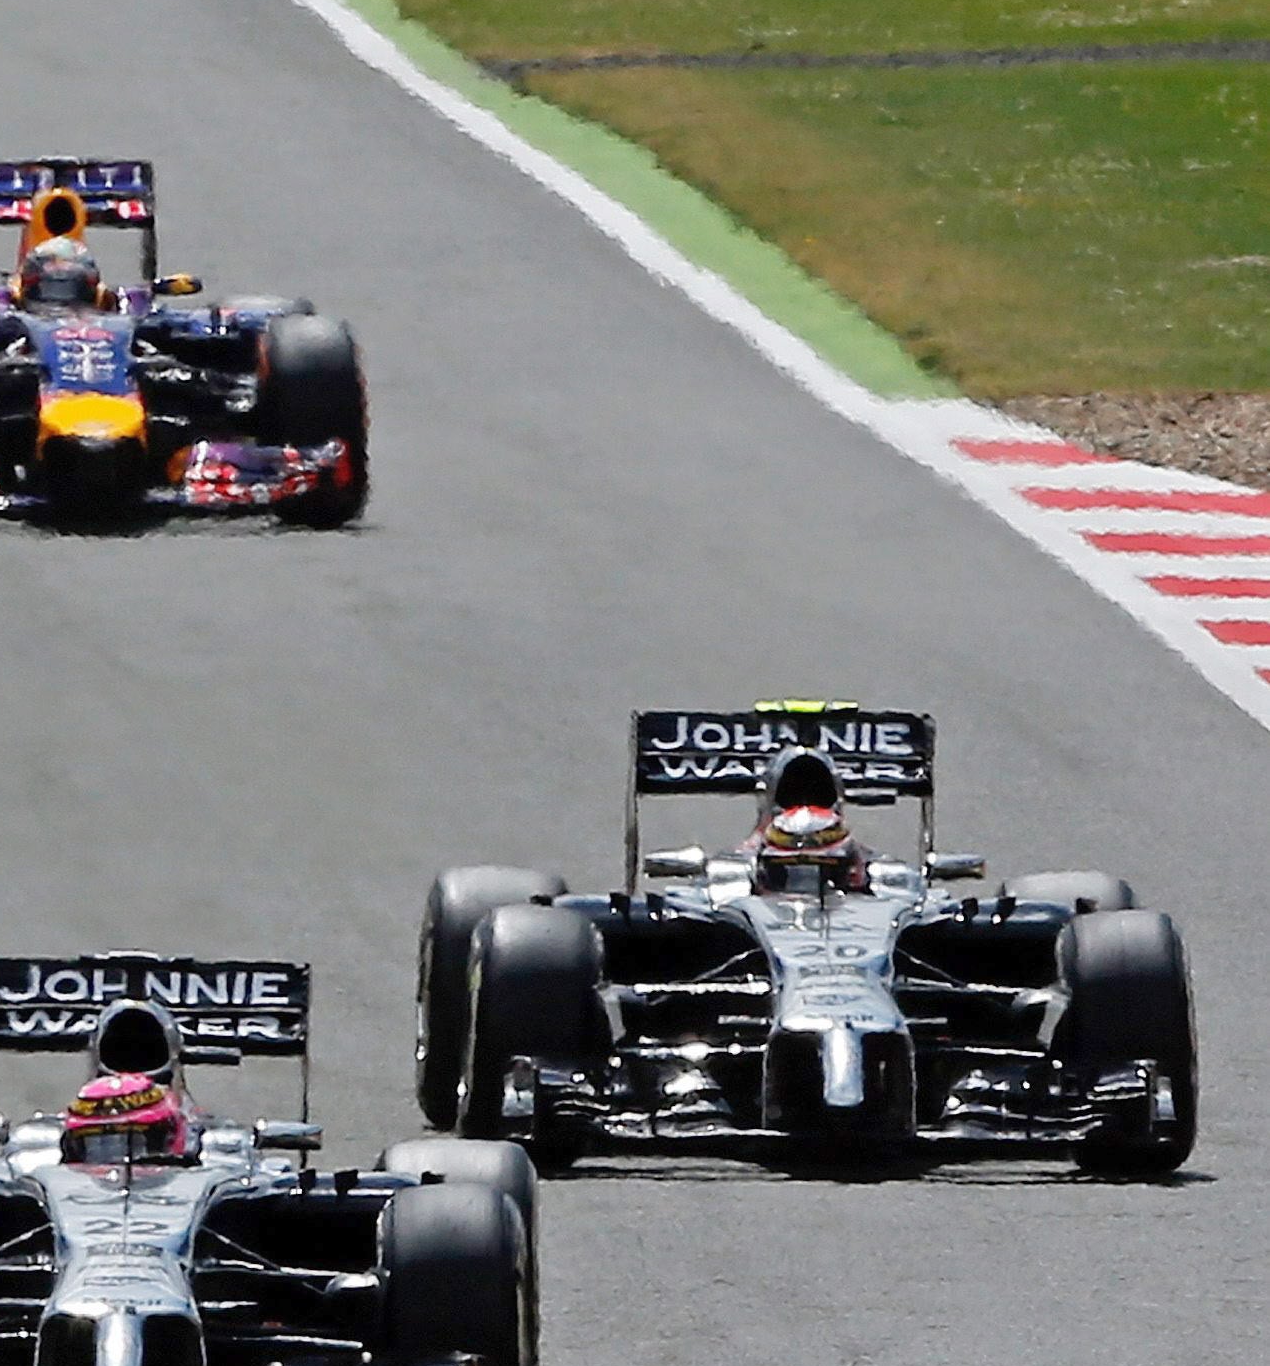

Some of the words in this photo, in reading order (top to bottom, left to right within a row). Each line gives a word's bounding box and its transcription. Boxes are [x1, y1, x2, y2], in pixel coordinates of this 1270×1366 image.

[793, 945, 868, 958] 20
[7, 1011, 284, 1037] WAKER
[84, 1220, 171, 1235] 22
